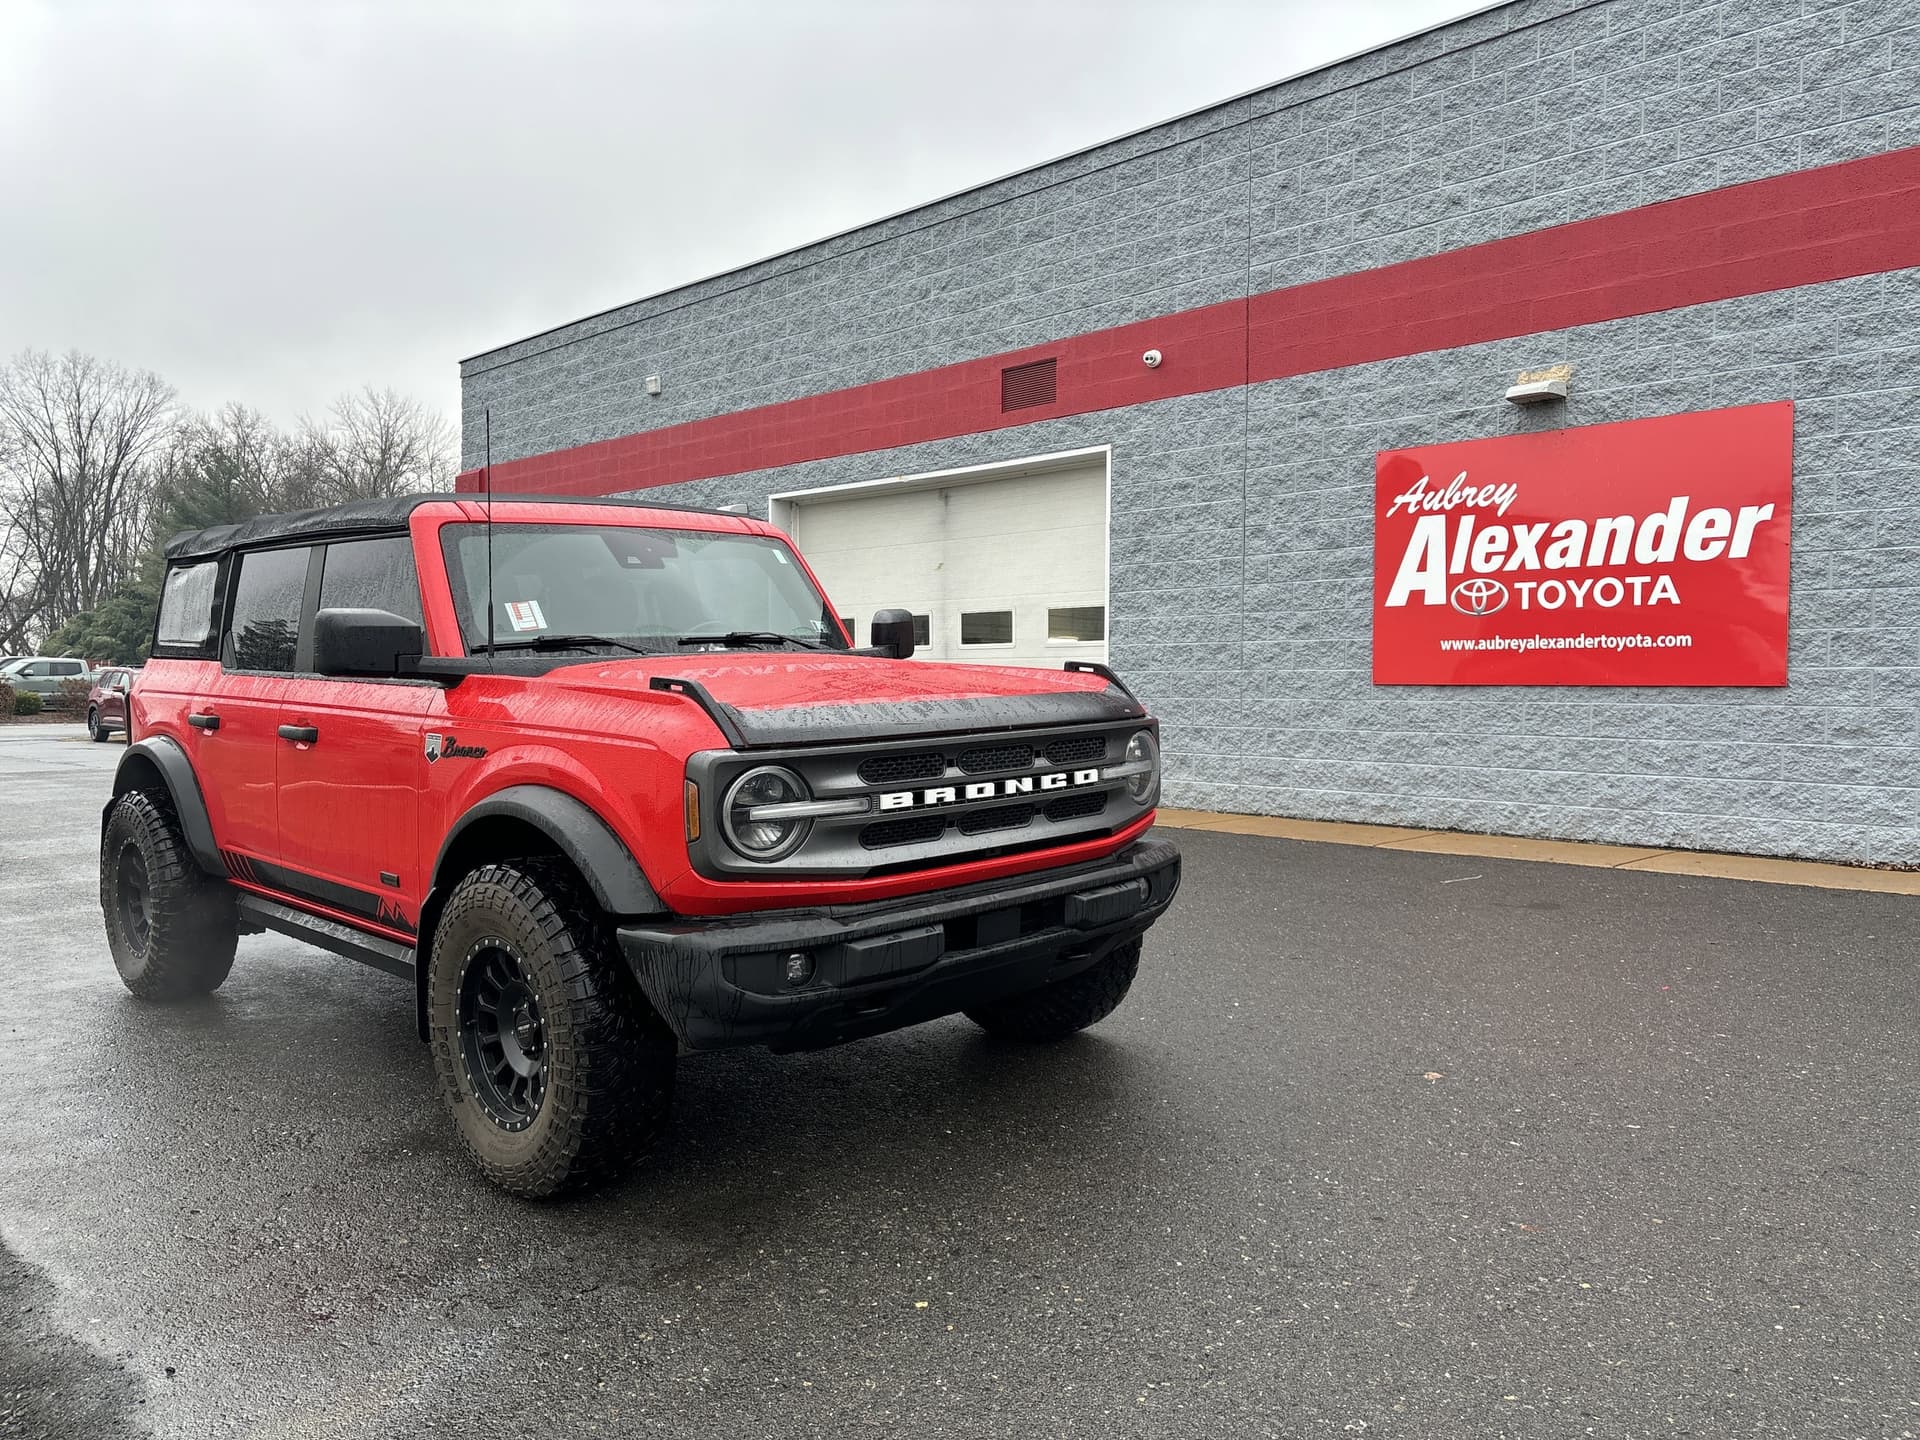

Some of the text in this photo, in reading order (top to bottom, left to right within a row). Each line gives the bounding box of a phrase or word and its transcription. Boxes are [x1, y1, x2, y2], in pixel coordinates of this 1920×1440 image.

[1386, 471, 1518, 518] Aubrey
[1384, 496, 1775, 607] Alexander
[1514, 574, 1681, 610] TOYOTA
[1440, 633, 1692, 653] www.aubreyalexandertoyota.com
[879, 768, 1099, 810] BRONCO
